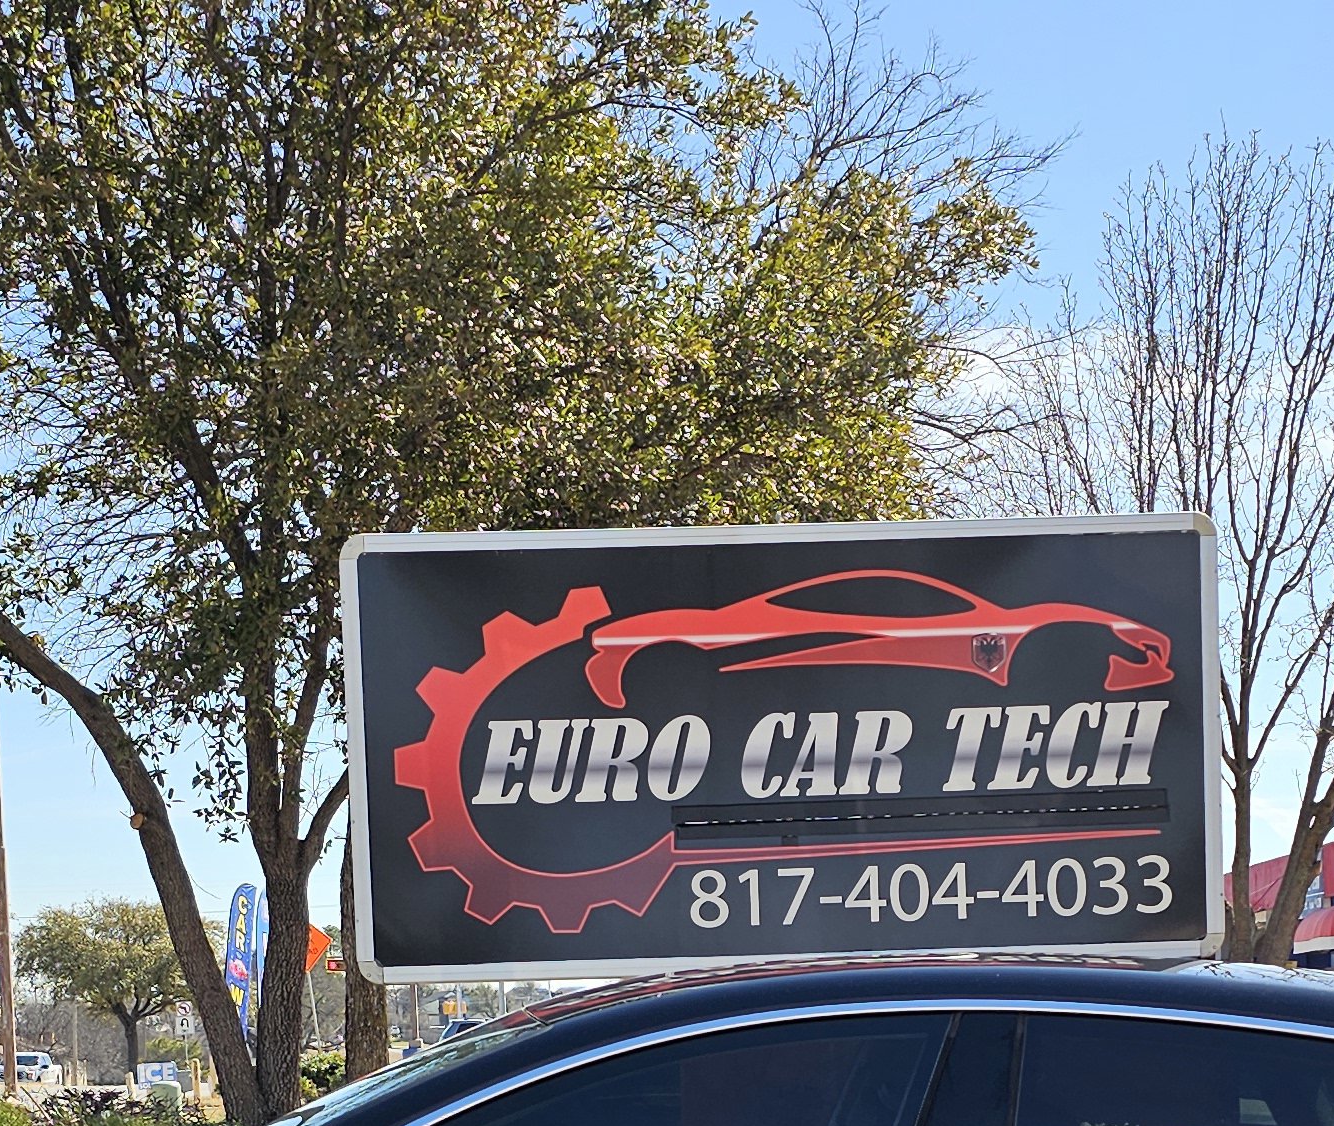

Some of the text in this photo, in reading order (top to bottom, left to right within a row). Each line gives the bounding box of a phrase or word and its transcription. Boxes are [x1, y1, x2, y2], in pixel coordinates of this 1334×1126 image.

[472, 700, 1170, 806] EURO CAR TECH
[235, 895, 250, 953] CAR
[689, 854, 1175, 930] 817-404-4033
[139, 1062, 175, 1082] ICE
